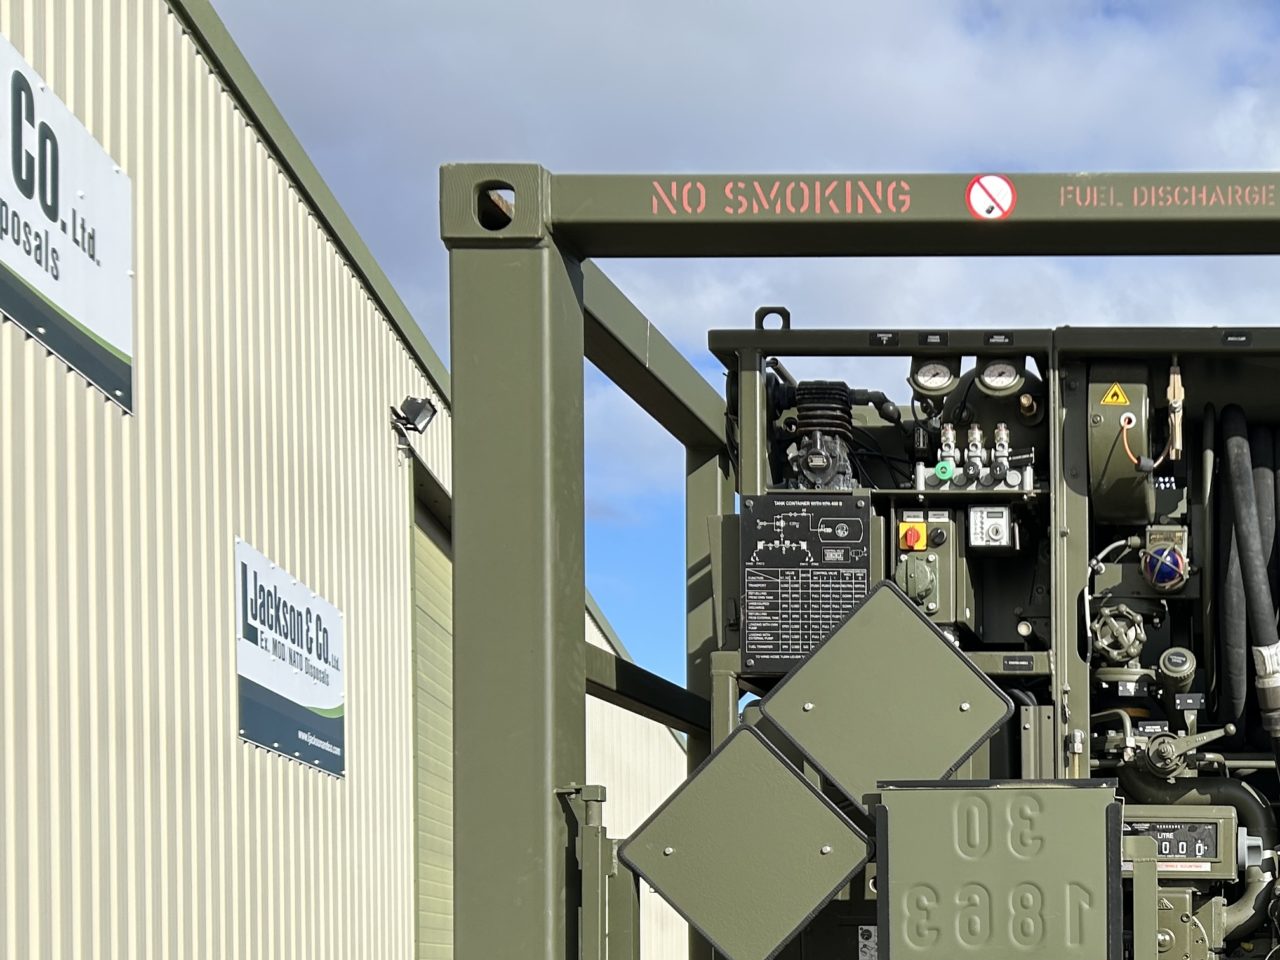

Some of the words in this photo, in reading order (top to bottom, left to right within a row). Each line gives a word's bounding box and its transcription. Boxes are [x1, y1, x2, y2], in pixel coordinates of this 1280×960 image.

[11, 69, 67, 235] Co.
[72, 207, 101, 267] Ltd.
[1060, 184, 1124, 207] FUEL
[1132, 184, 1277, 207] DISCHARGE
[652, 181, 706, 215] NO
[724, 180, 911, 215] SMOKING
[249, 569, 303, 650] Jackson
